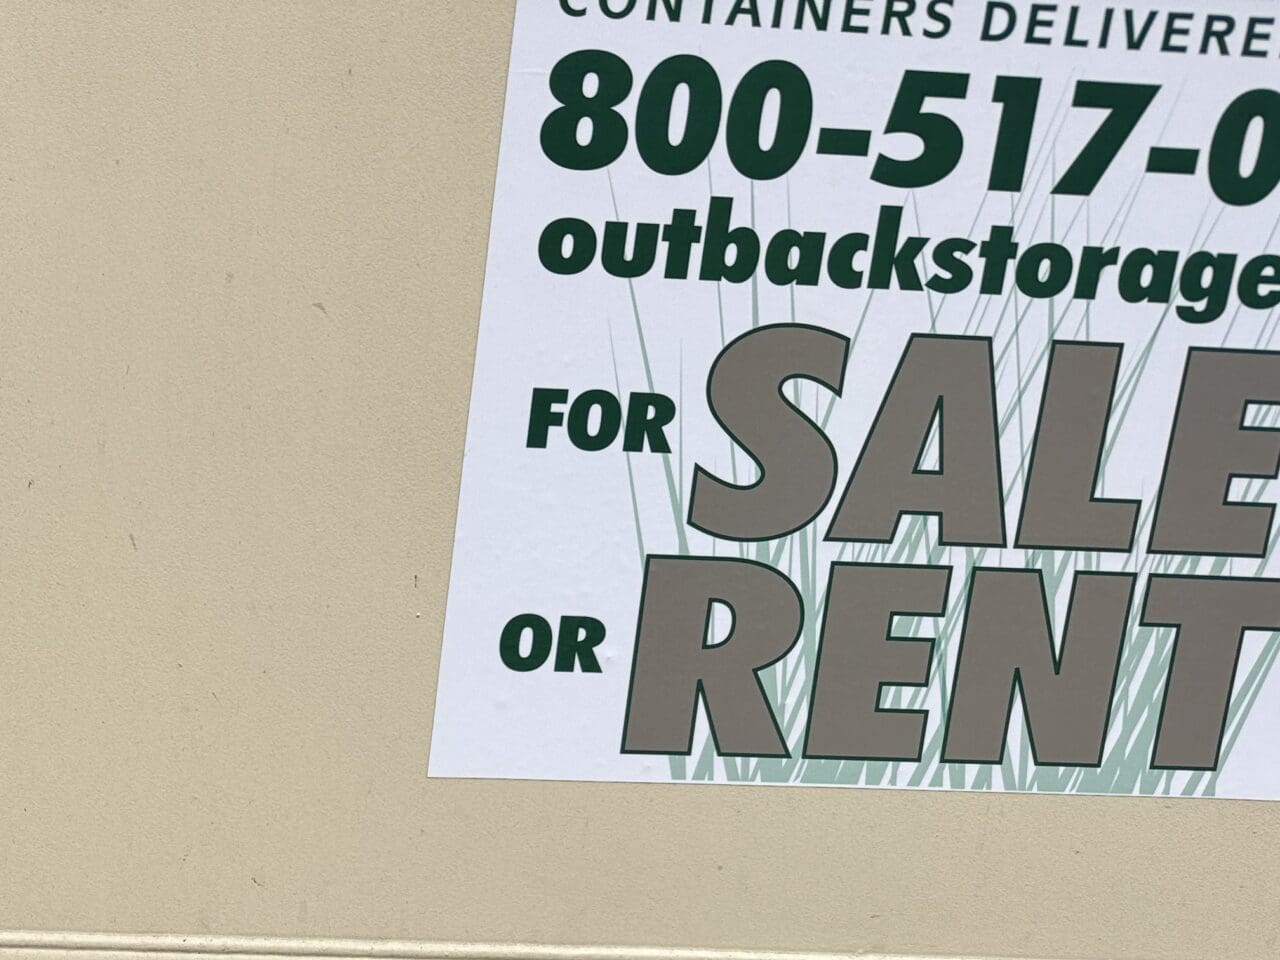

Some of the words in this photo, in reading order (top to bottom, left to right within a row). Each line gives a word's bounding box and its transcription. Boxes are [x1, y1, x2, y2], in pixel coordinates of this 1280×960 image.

[980, 0, 1280, 59] DELIVERE
[539, 49, 1280, 207] 800-517-0
[538, 196, 1280, 324] outbackstorage
[526, 387, 676, 454] FOR
[686, 322, 1280, 559] SALE
[499, 613, 606, 674] OR
[619, 553, 1280, 772] RENT
